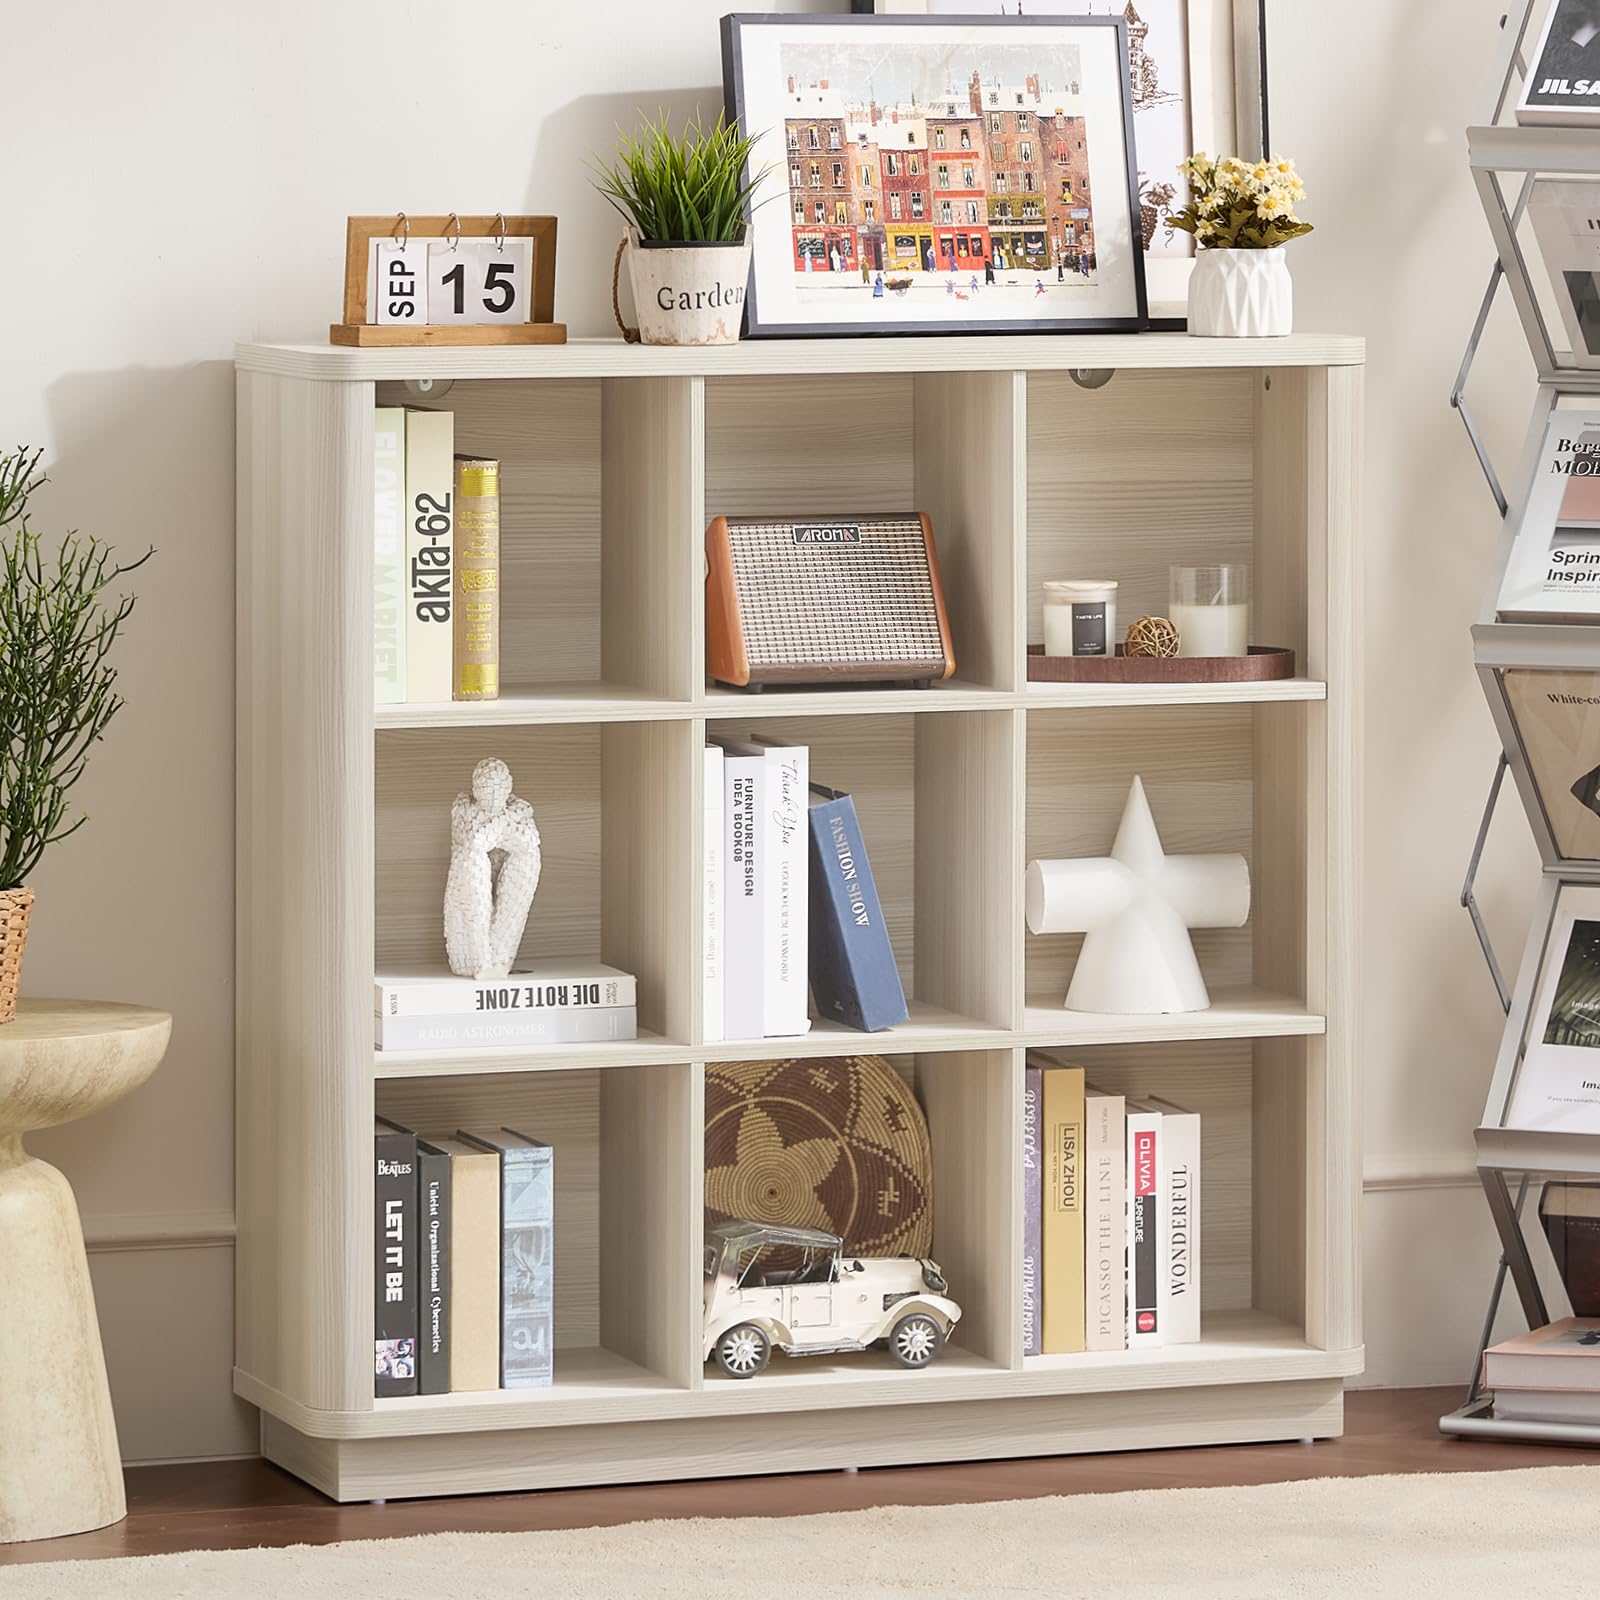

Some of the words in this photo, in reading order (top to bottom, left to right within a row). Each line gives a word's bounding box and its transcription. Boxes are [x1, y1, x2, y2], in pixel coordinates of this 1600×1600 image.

[389, 259, 415, 318] SEP
[657, 281, 743, 311] Garden
[801, 529, 855, 542] AROMA
[1547, 568, 1600, 584] Inspir
[1547, 694, 1600, 704] White-co
[733, 778, 743, 808] IDEA
[744, 777, 754, 847] FURNITURE
[733, 812, 743, 863] BOOK08
[744, 851, 754, 897] DESIGN
[829, 816, 857, 881] FASHION
[845, 882, 870, 927] SHOW
[390, 994, 398, 1015] DESIGN
[475, 987, 520, 1011] ZONE
[525, 985, 569, 1008] ROTE
[572, 983, 600, 1006] DIE
[1063, 1127, 1075, 1159] LISA
[378, 1160, 412, 1177] BEATLES
[1100, 1157, 1111, 1206] LINE
[1138, 1137, 1151, 1191] OLIVIA
[1063, 1163, 1075, 1207] ZHOU
[386, 1200, 403, 1241] LET
[1100, 1213, 1111, 1254] THE
[1135, 1196, 1144, 1243] FURNITURE
[1171, 1164, 1188, 1296] WONDERFUL
[386, 1246, 403, 1267] IT
[386, 1272, 403, 1302] BE
[1100, 1258, 1111, 1336] PICASSO
[431, 1296, 442, 1353] Cybernetics
